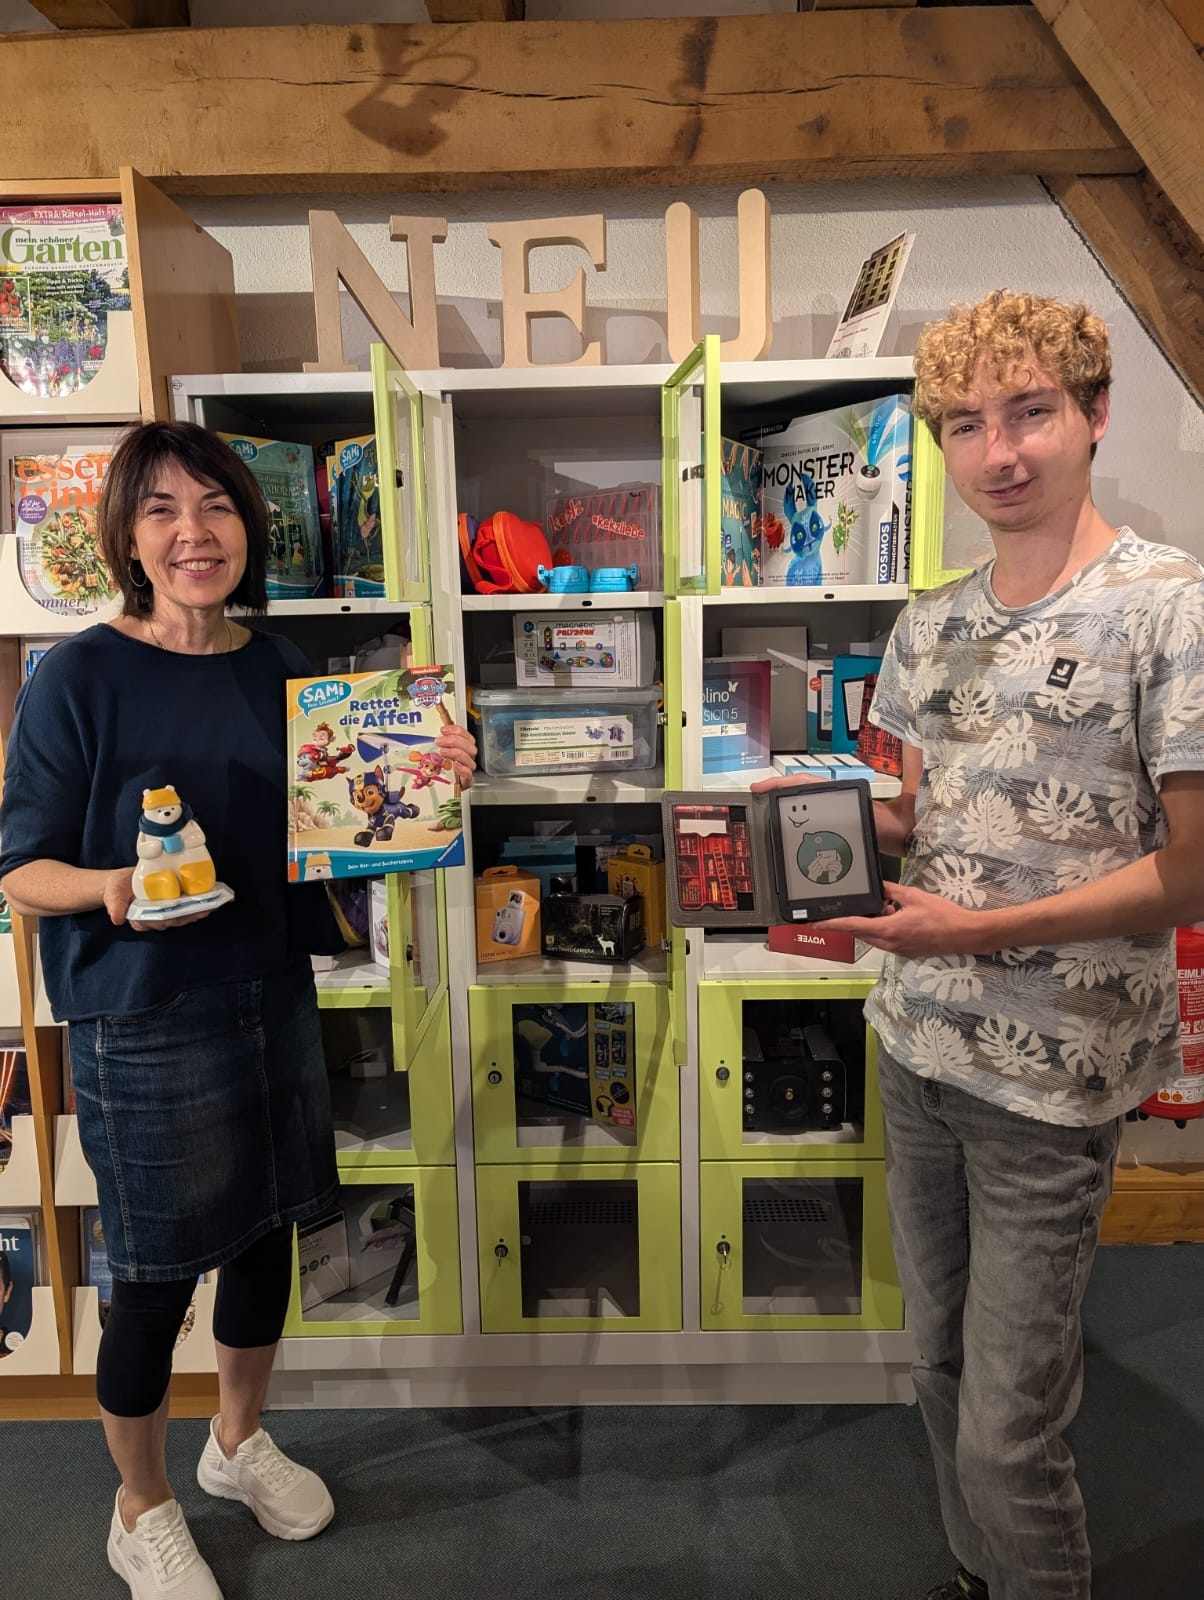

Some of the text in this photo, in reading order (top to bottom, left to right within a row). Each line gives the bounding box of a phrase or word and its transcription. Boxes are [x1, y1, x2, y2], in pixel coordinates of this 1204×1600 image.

[1, 227, 125, 264] Garten
[15, 235, 37, 243] mein
[303, 188, 772, 372] NEU
[341, 446, 360, 464] SAMi
[763, 451, 855, 488] MONSTER
[785, 480, 836, 503] MAKER
[722, 498, 747, 520] MAGIC
[879, 524, 890, 582] KOSMOS
[303, 682, 345, 704] SAMi
[702, 687, 730, 704] lino
[350, 696, 399, 712] Rettet
[339, 710, 422, 729] die Affen
[796, 934, 826, 945] VOYEE
[1177, 967, 1204, 979] EIMLI
